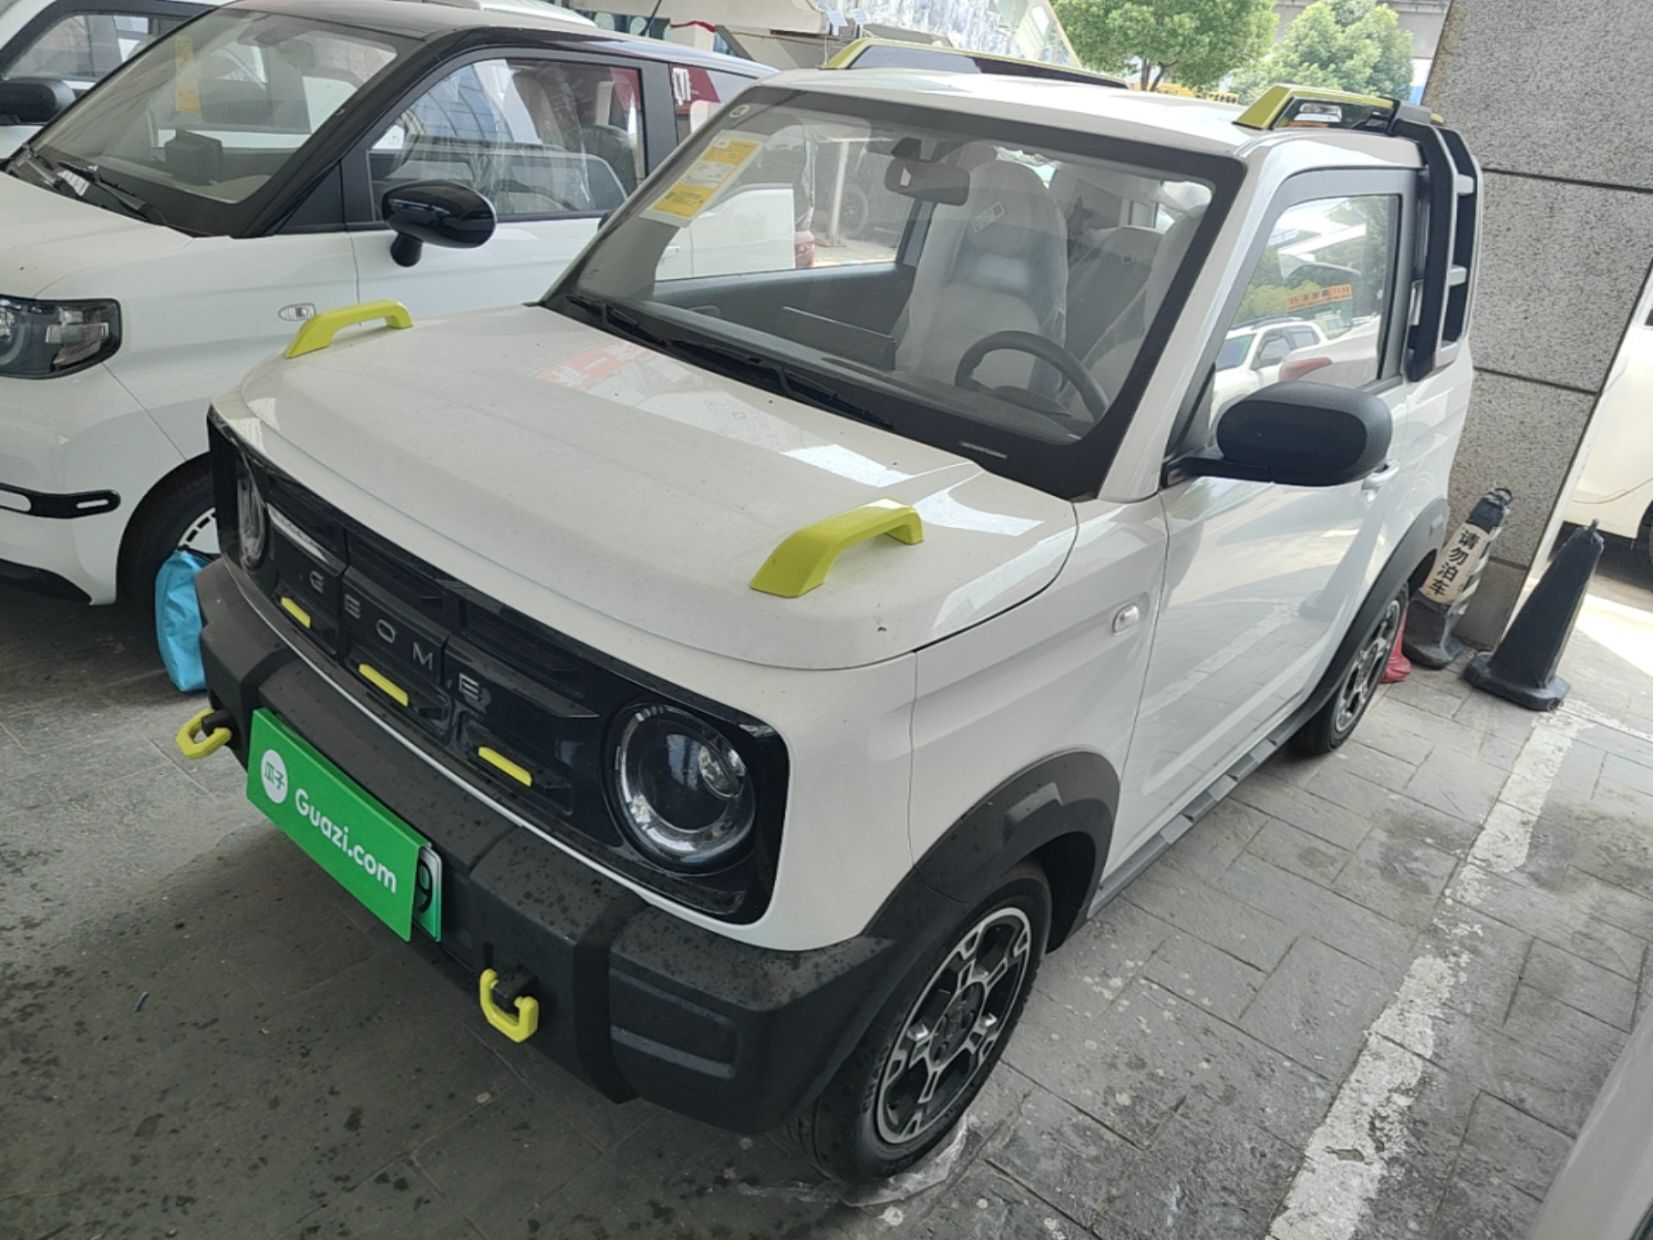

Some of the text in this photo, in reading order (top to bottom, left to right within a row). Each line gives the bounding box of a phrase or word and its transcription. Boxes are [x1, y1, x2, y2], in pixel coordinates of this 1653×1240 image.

[1429, 530, 1480, 596] 请勿泊车
[295, 788, 397, 894] Guazi.com
